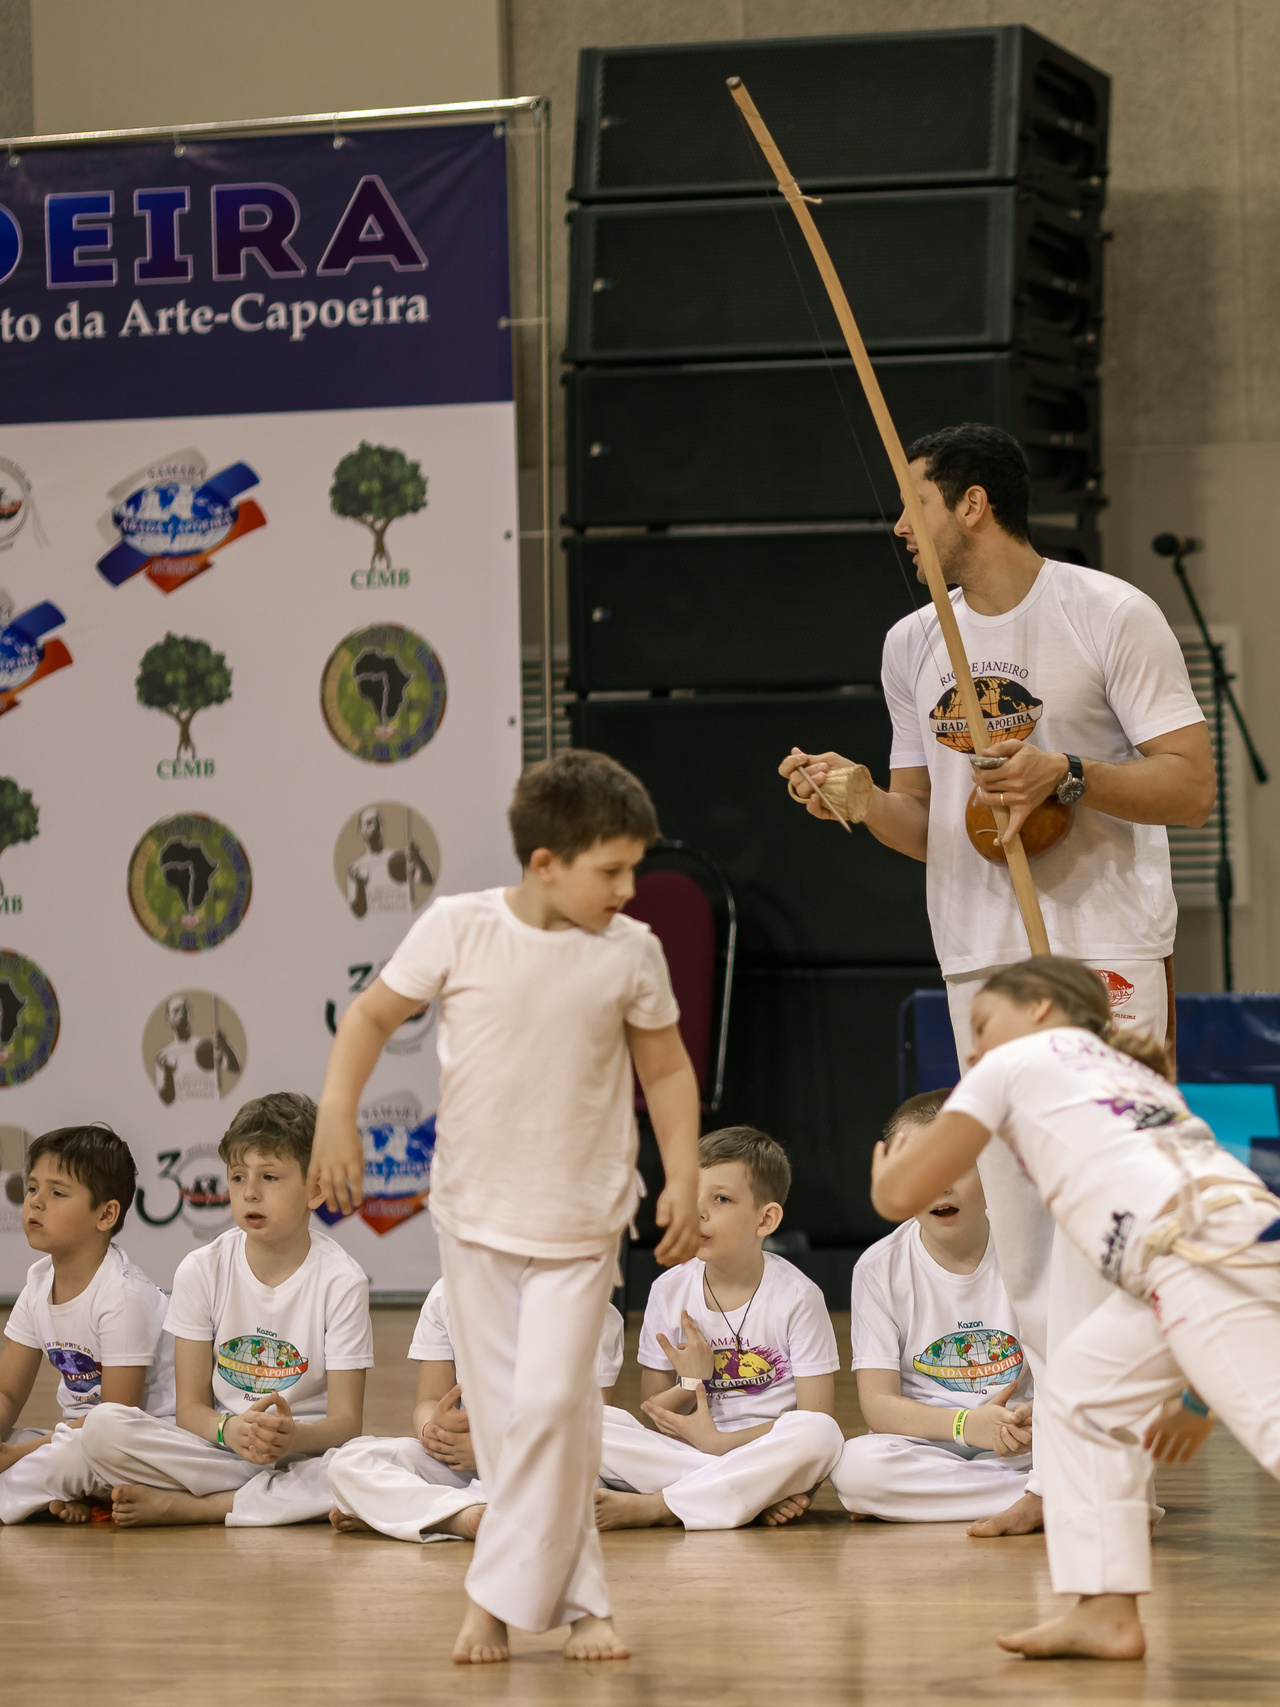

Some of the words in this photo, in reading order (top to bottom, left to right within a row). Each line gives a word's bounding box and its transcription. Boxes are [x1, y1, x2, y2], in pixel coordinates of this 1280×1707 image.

[0, 173, 429, 290] EIRA
[54, 299, 106, 341] da
[119, 286, 429, 341] Arte-Capoeira
[350, 568, 411, 590] CEMB
[979, 660, 1029, 680] JANEIRO
[156, 758, 216, 780] CEMB
[256, 1326, 278, 1338] Kazan
[956, 1320, 984, 1329] Kazan
